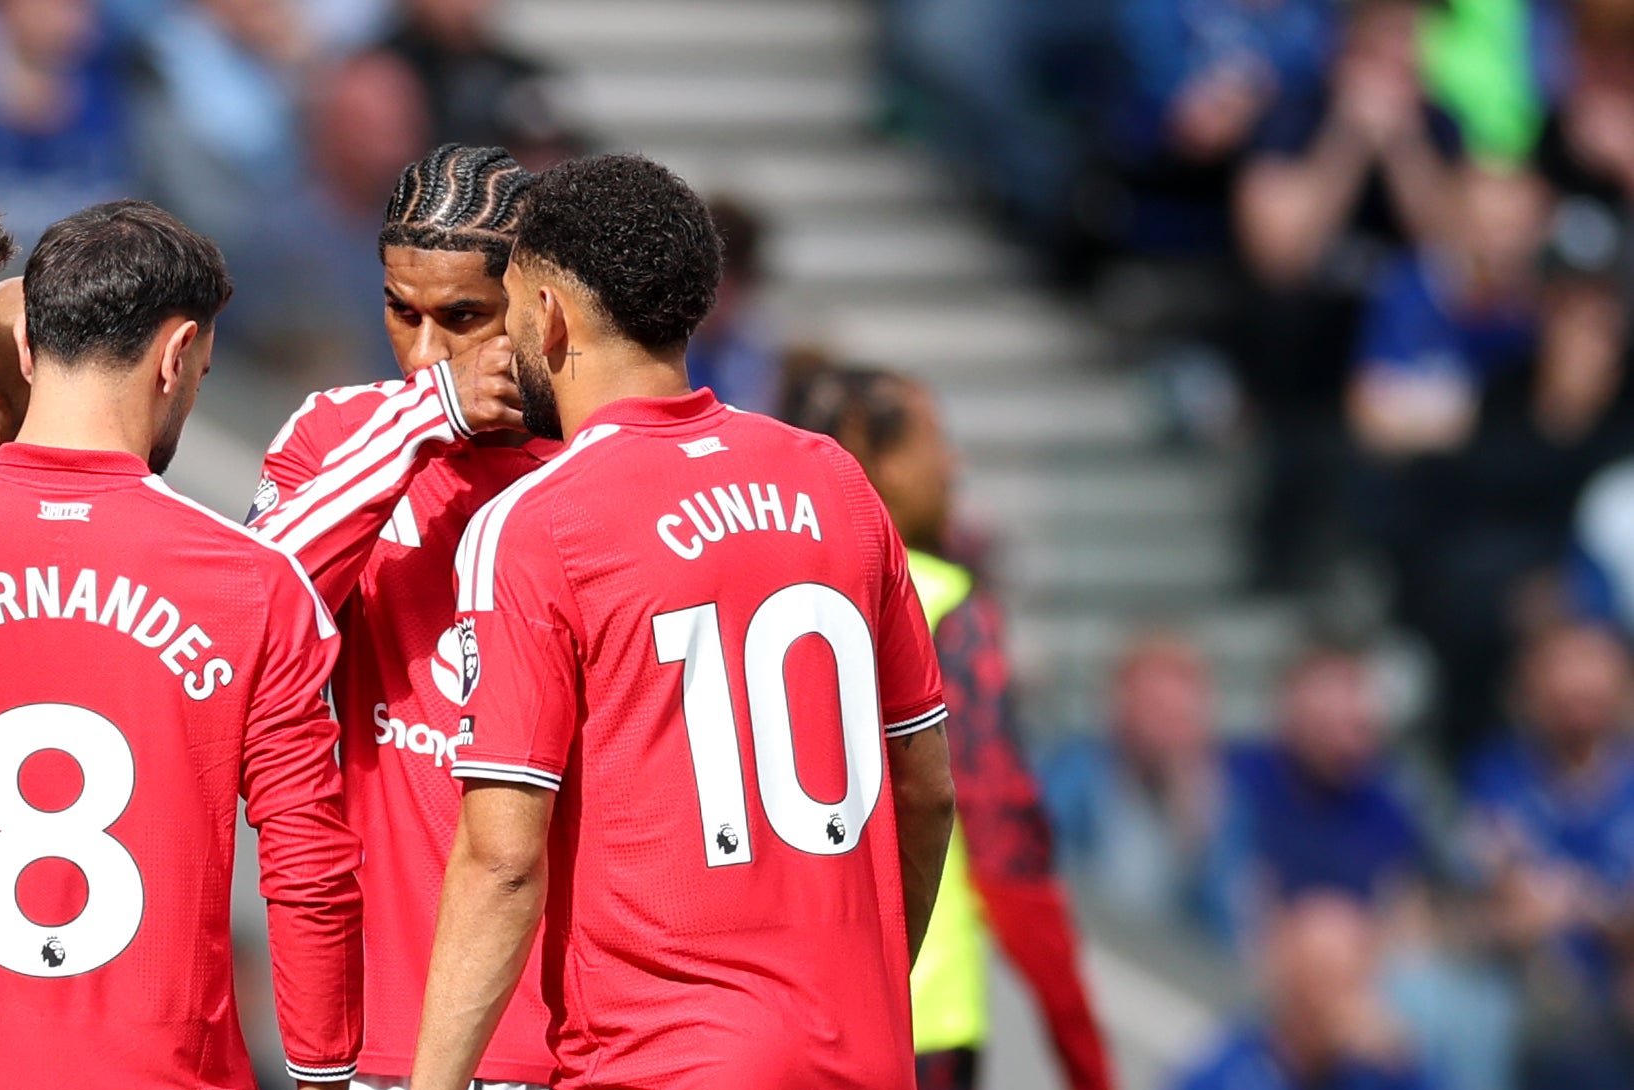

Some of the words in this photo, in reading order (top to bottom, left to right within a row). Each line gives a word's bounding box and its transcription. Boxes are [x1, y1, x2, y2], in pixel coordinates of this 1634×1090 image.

[37, 500, 93, 522] UNITED
[656, 484, 823, 561] CUNHA
[652, 582, 885, 869] 10
